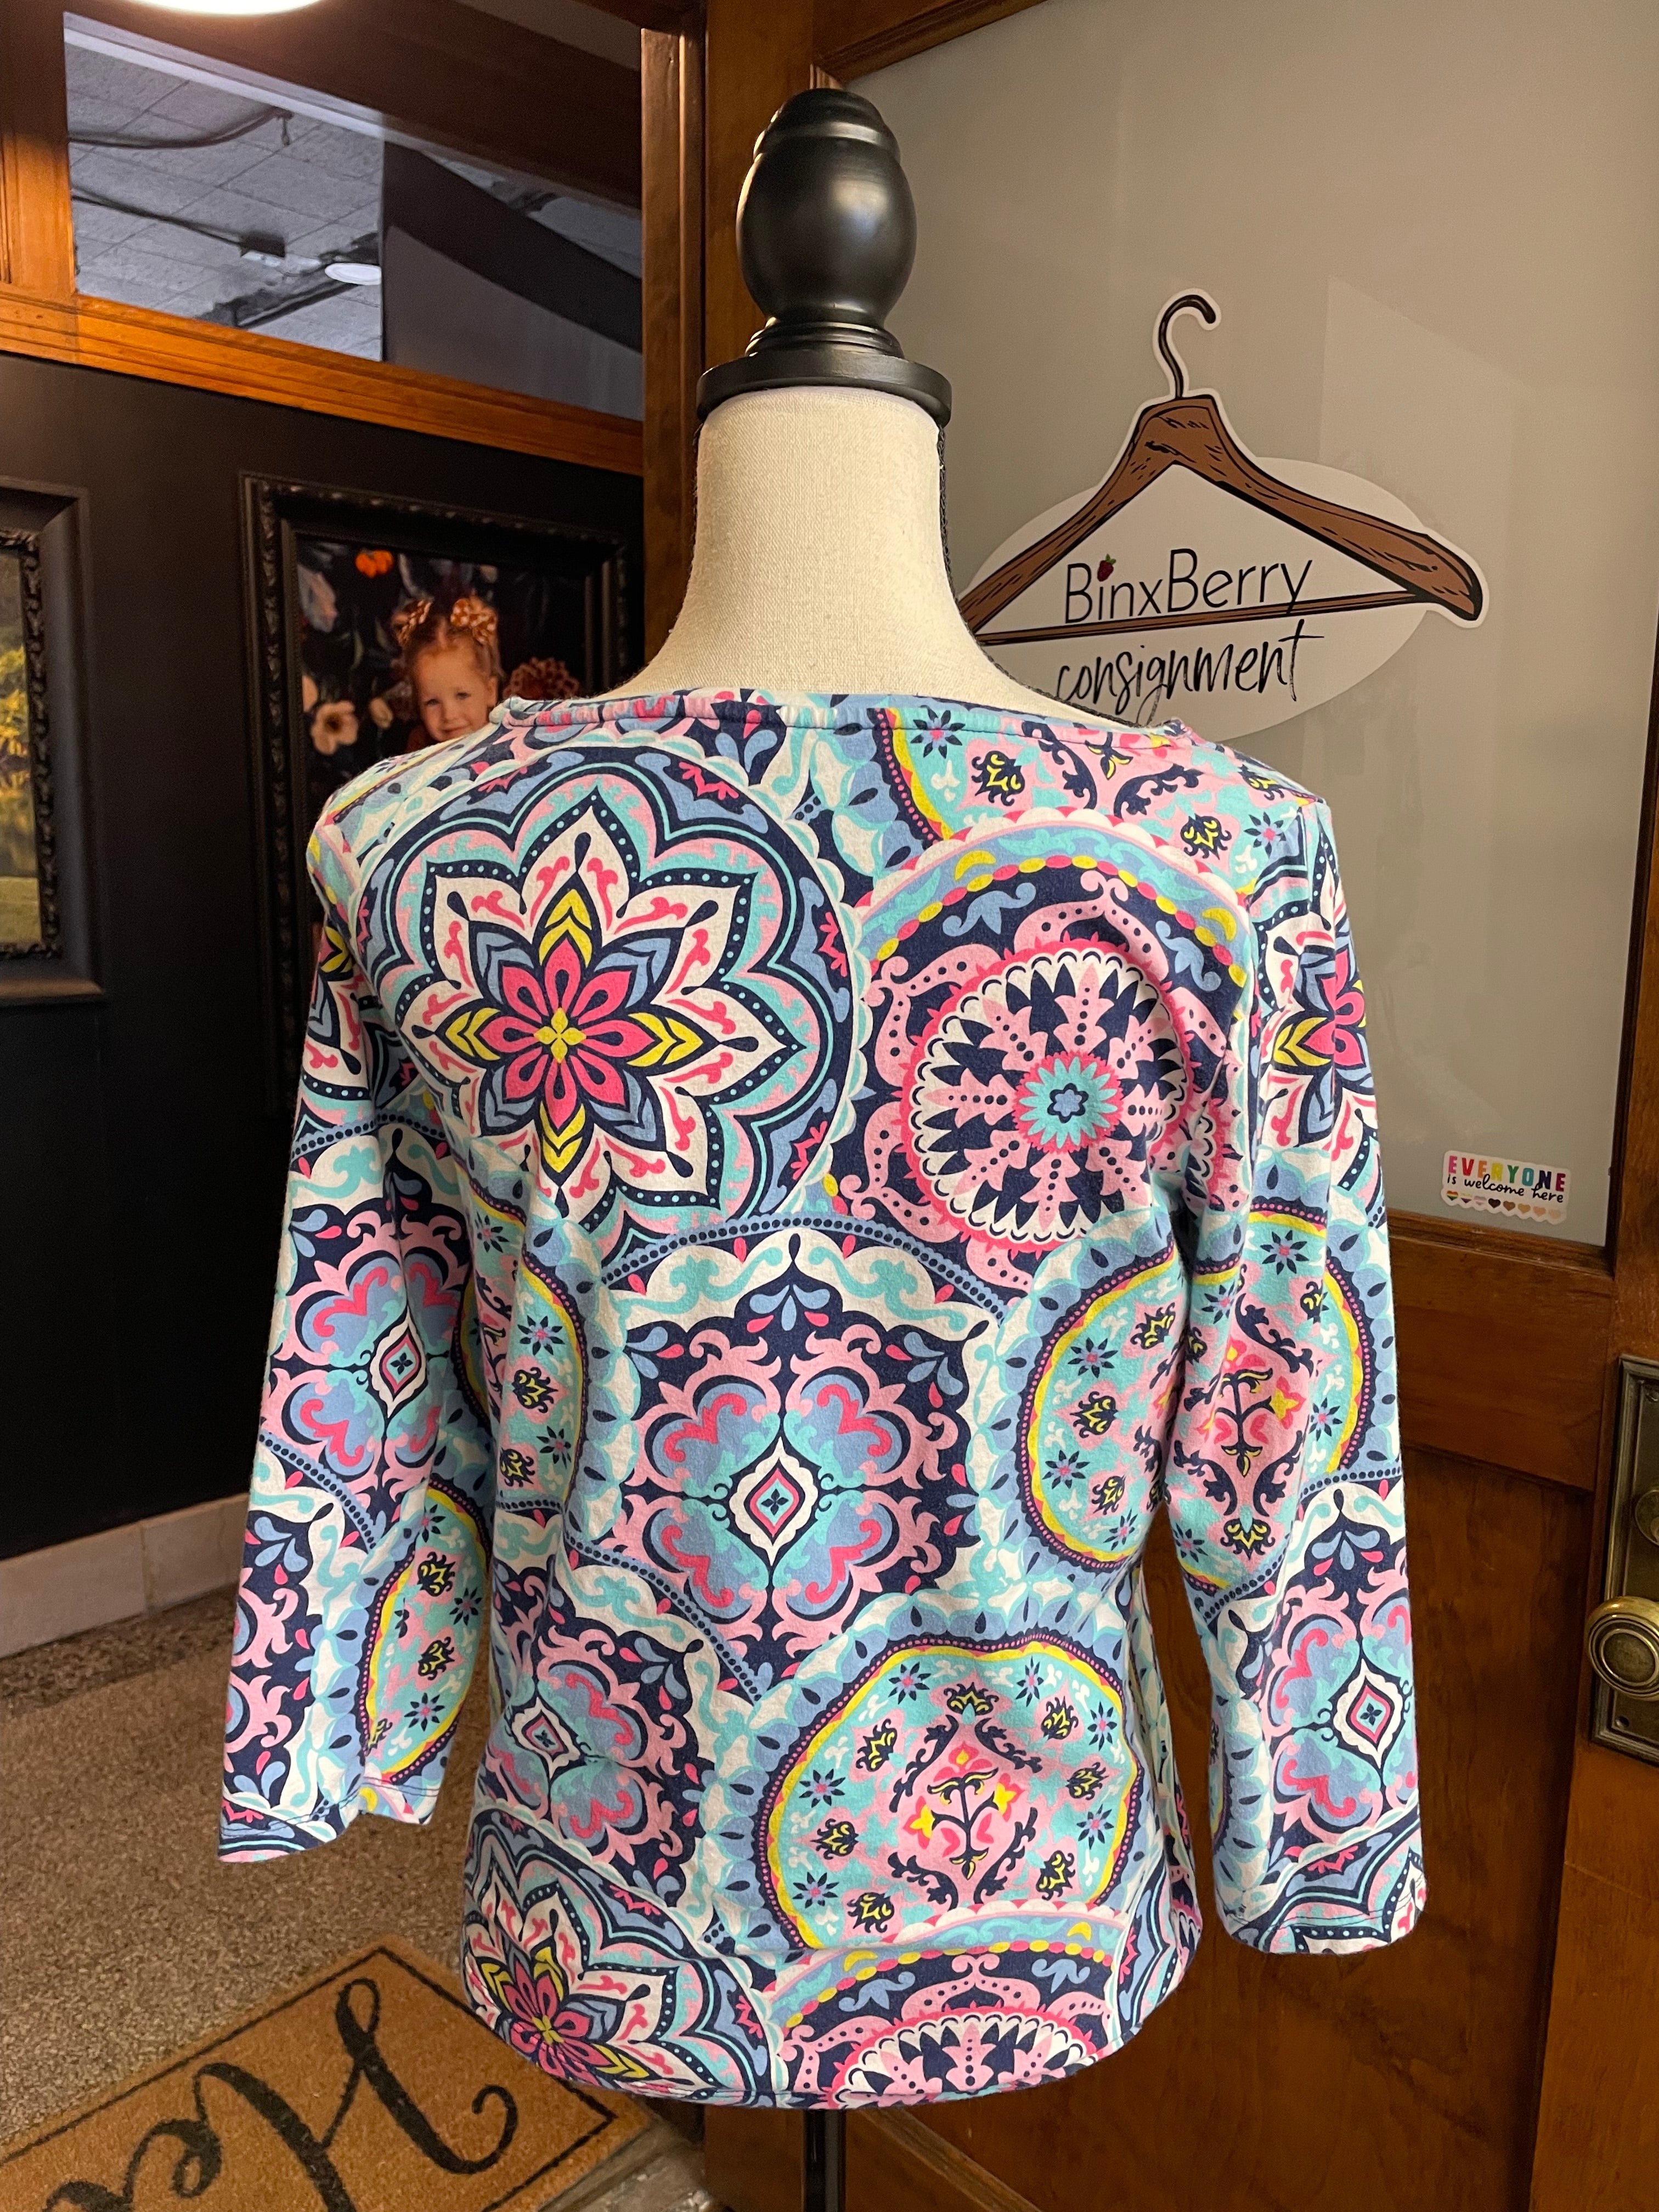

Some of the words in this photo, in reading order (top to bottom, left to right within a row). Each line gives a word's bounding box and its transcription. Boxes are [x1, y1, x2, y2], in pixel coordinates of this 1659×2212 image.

[1064, 548, 1313, 624] BinxBerry
[1056, 618, 1325, 726] consignment
[1447, 1173, 1457, 1185] is
[1464, 1173, 1525, 1196] welcome
[1531, 1181, 1564, 1203] here
[1448, 1155, 1566, 1192] EVERYONE
